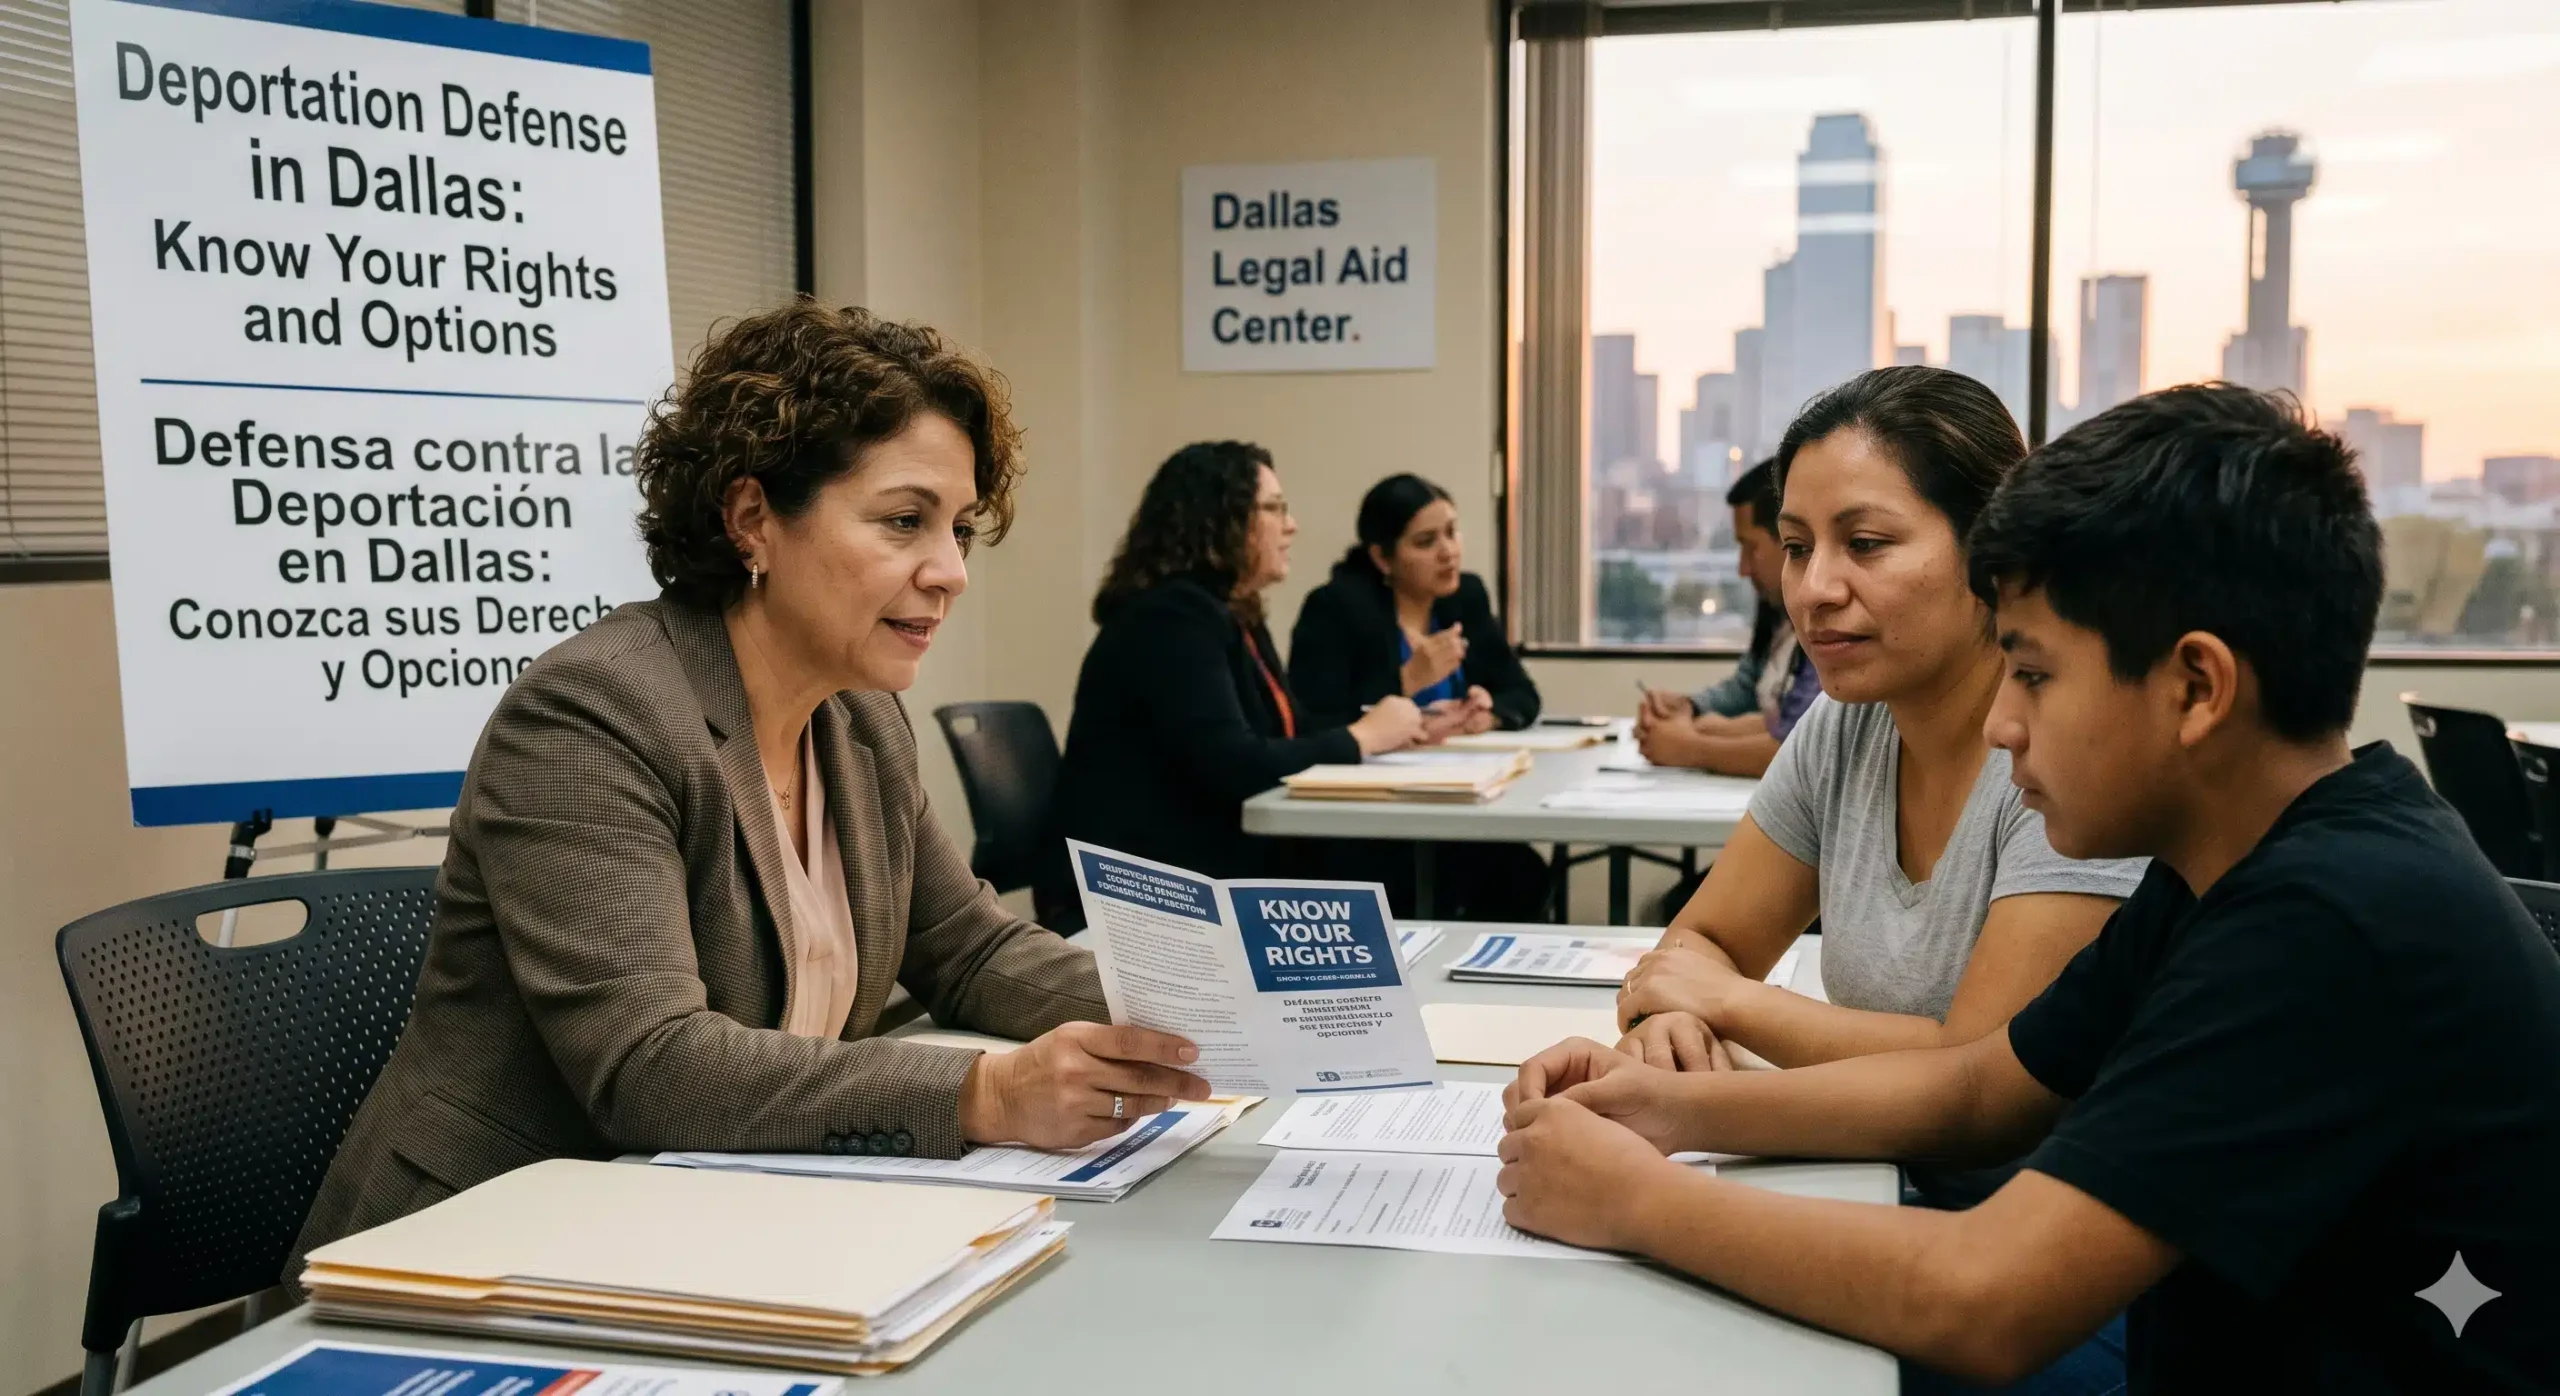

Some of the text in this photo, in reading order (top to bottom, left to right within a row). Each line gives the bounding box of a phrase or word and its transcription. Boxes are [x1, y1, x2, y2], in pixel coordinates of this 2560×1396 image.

[117, 42, 627, 155] Deportation Defense
[250, 137, 524, 223] in Dallas:
[1211, 189, 1341, 231] Dallas
[154, 219, 618, 308] Know Your Rights
[1212, 246, 1408, 297] Legal Aid
[244, 298, 557, 362] and Options
[154, 417, 637, 476] Defensa contra la
[232, 479, 572, 538] Deportación
[278, 537, 551, 584] en Dallas:
[169, 597, 370, 641] Conozca
[386, 606, 461, 637] sus
[322, 660, 346, 702] y
[1258, 899, 1351, 921] KNOW
[1269, 923, 1356, 943] YOUR
[1264, 945, 1374, 966] RIGHTS
